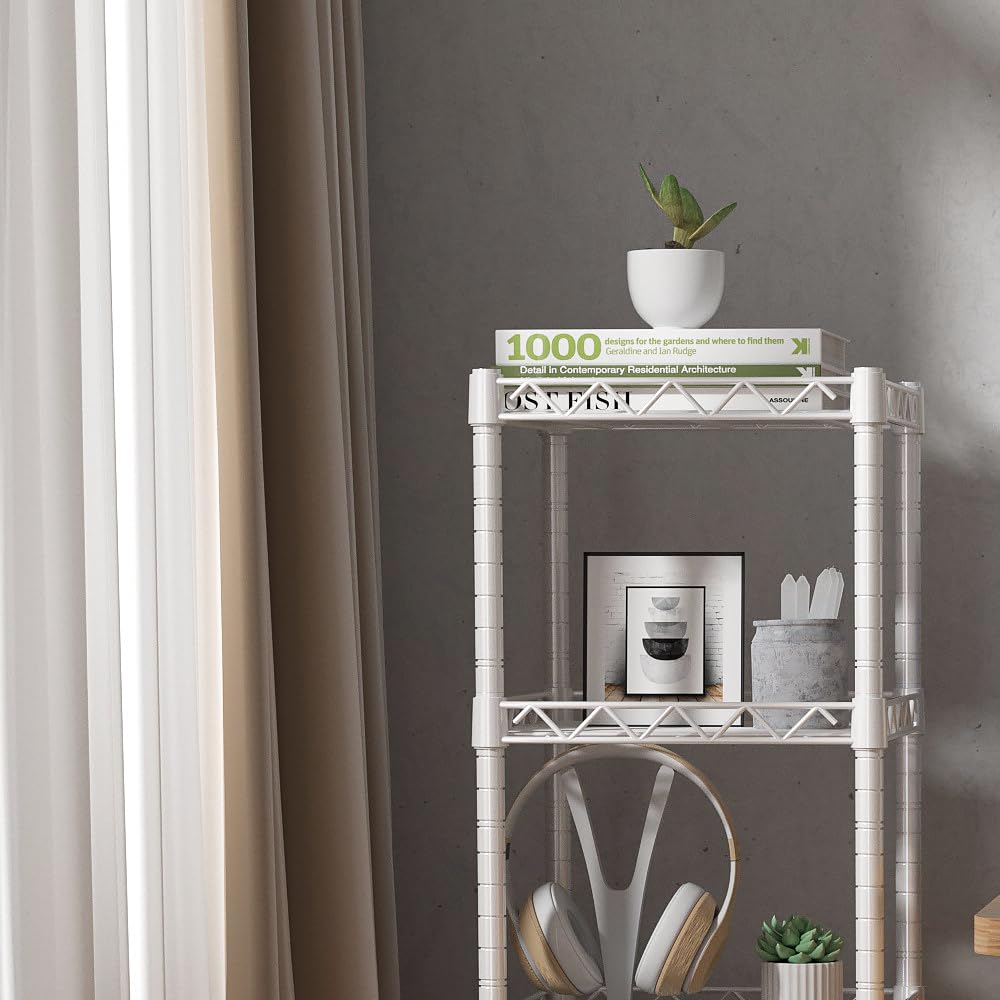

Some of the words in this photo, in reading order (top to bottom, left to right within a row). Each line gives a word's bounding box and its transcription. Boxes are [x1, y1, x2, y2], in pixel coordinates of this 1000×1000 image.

[506, 333, 602, 361] 1000
[604, 338, 635, 347] designs
[636, 337, 647, 345] for
[648, 337, 662, 345] the
[663, 337, 694, 347] gardens
[695, 337, 710, 345] and
[710, 337, 736, 345] where
[747, 337, 763, 345] find
[764, 337, 785, 345] them
[605, 347, 642, 355] Geraldine
[642, 347, 658, 355] and
[659, 347, 671, 355] Ian
[672, 347, 696, 357] Rudge
[519, 366, 547, 374] Detail
[548, 366, 557, 374] in
[559, 366, 625, 375] Contemporary
[627, 365, 679, 374] Residential
[681, 365, 737, 374] Architecture
[504, 391, 559, 410] OST
